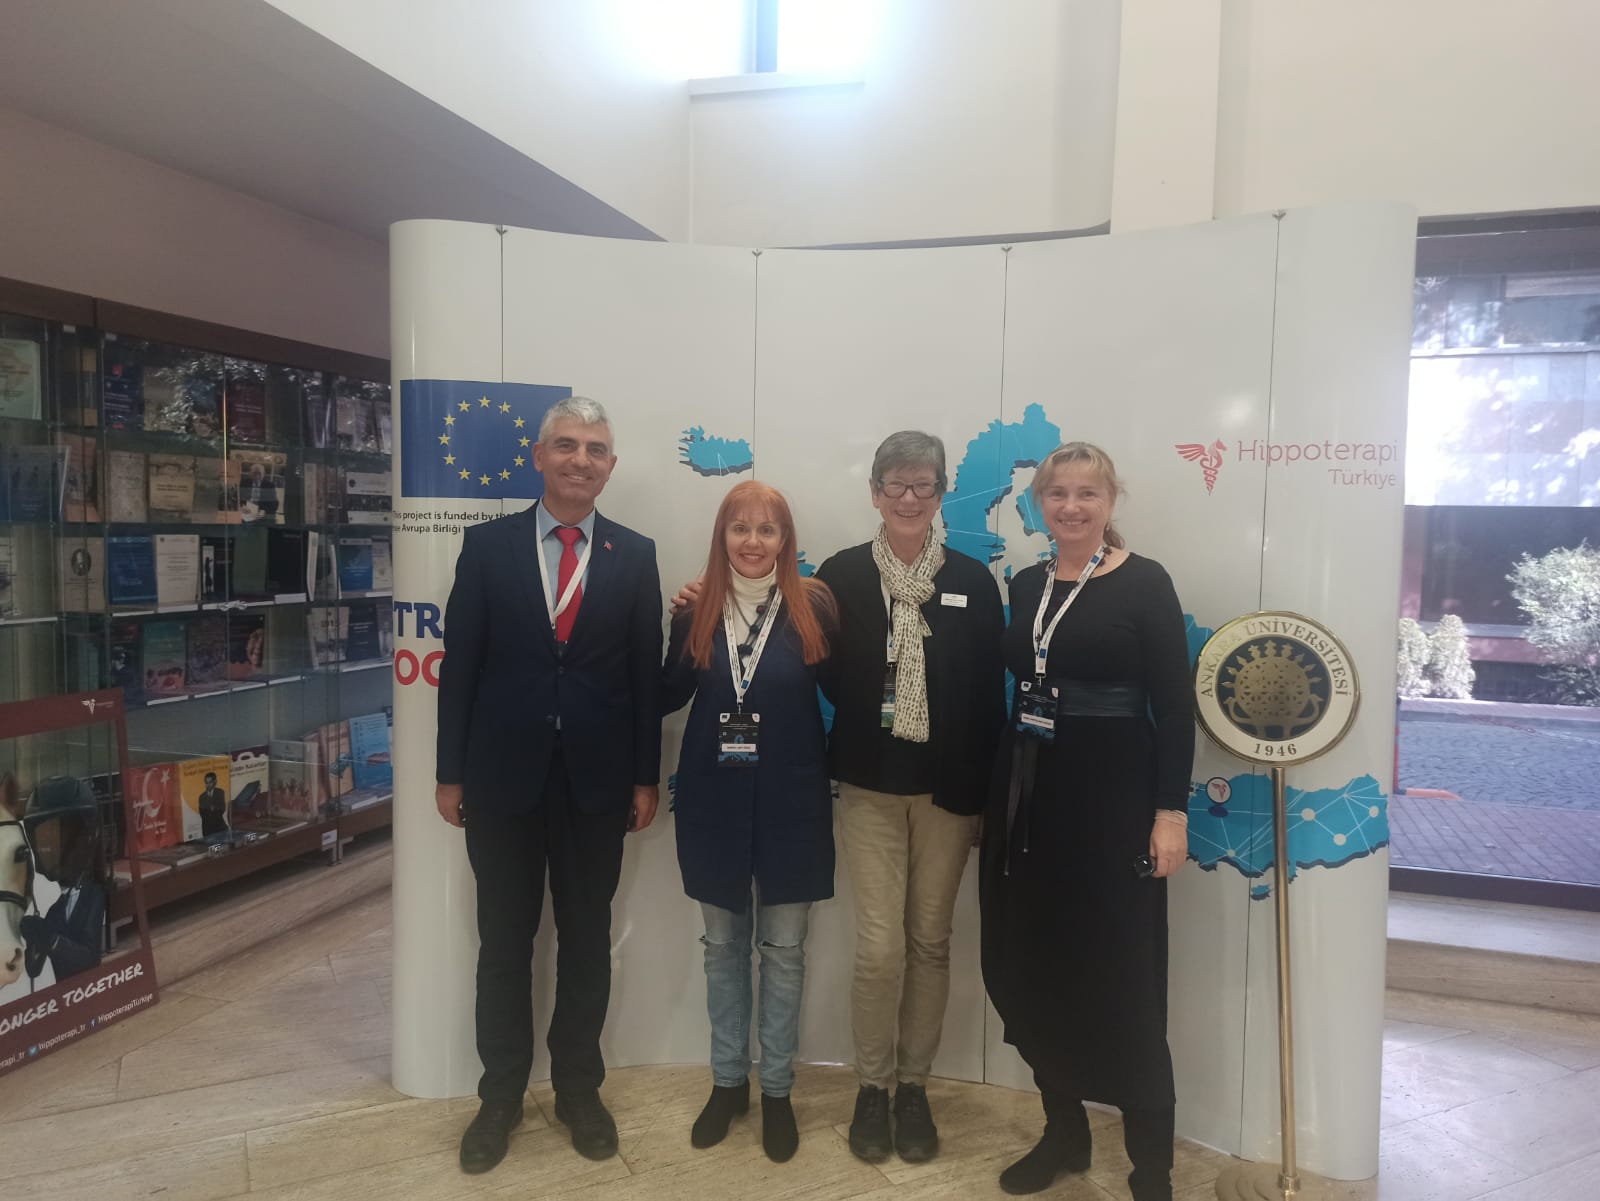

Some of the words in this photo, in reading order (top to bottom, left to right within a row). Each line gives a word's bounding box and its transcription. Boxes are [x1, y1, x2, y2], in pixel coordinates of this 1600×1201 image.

[1237, 439, 1398, 467] Hippoterapi
[1327, 468, 1397, 490] Türkiye
[401, 523, 430, 534] Avrupa
[433, 524, 461, 535] Birliği
[402, 510, 432, 523] project
[434, 510, 442, 520] is
[443, 511, 479, 521] funded
[481, 512, 495, 522] by
[393, 601, 443, 639] TR
[1244, 618, 1352, 696] ÜNİVERSİTESİ
[1253, 743, 1297, 757] 1946
[0, 999, 59, 1036] ONGER
[62, 962, 144, 1007] TOGETHER
[38, 1023, 86, 1050] hippoterapi_tr
